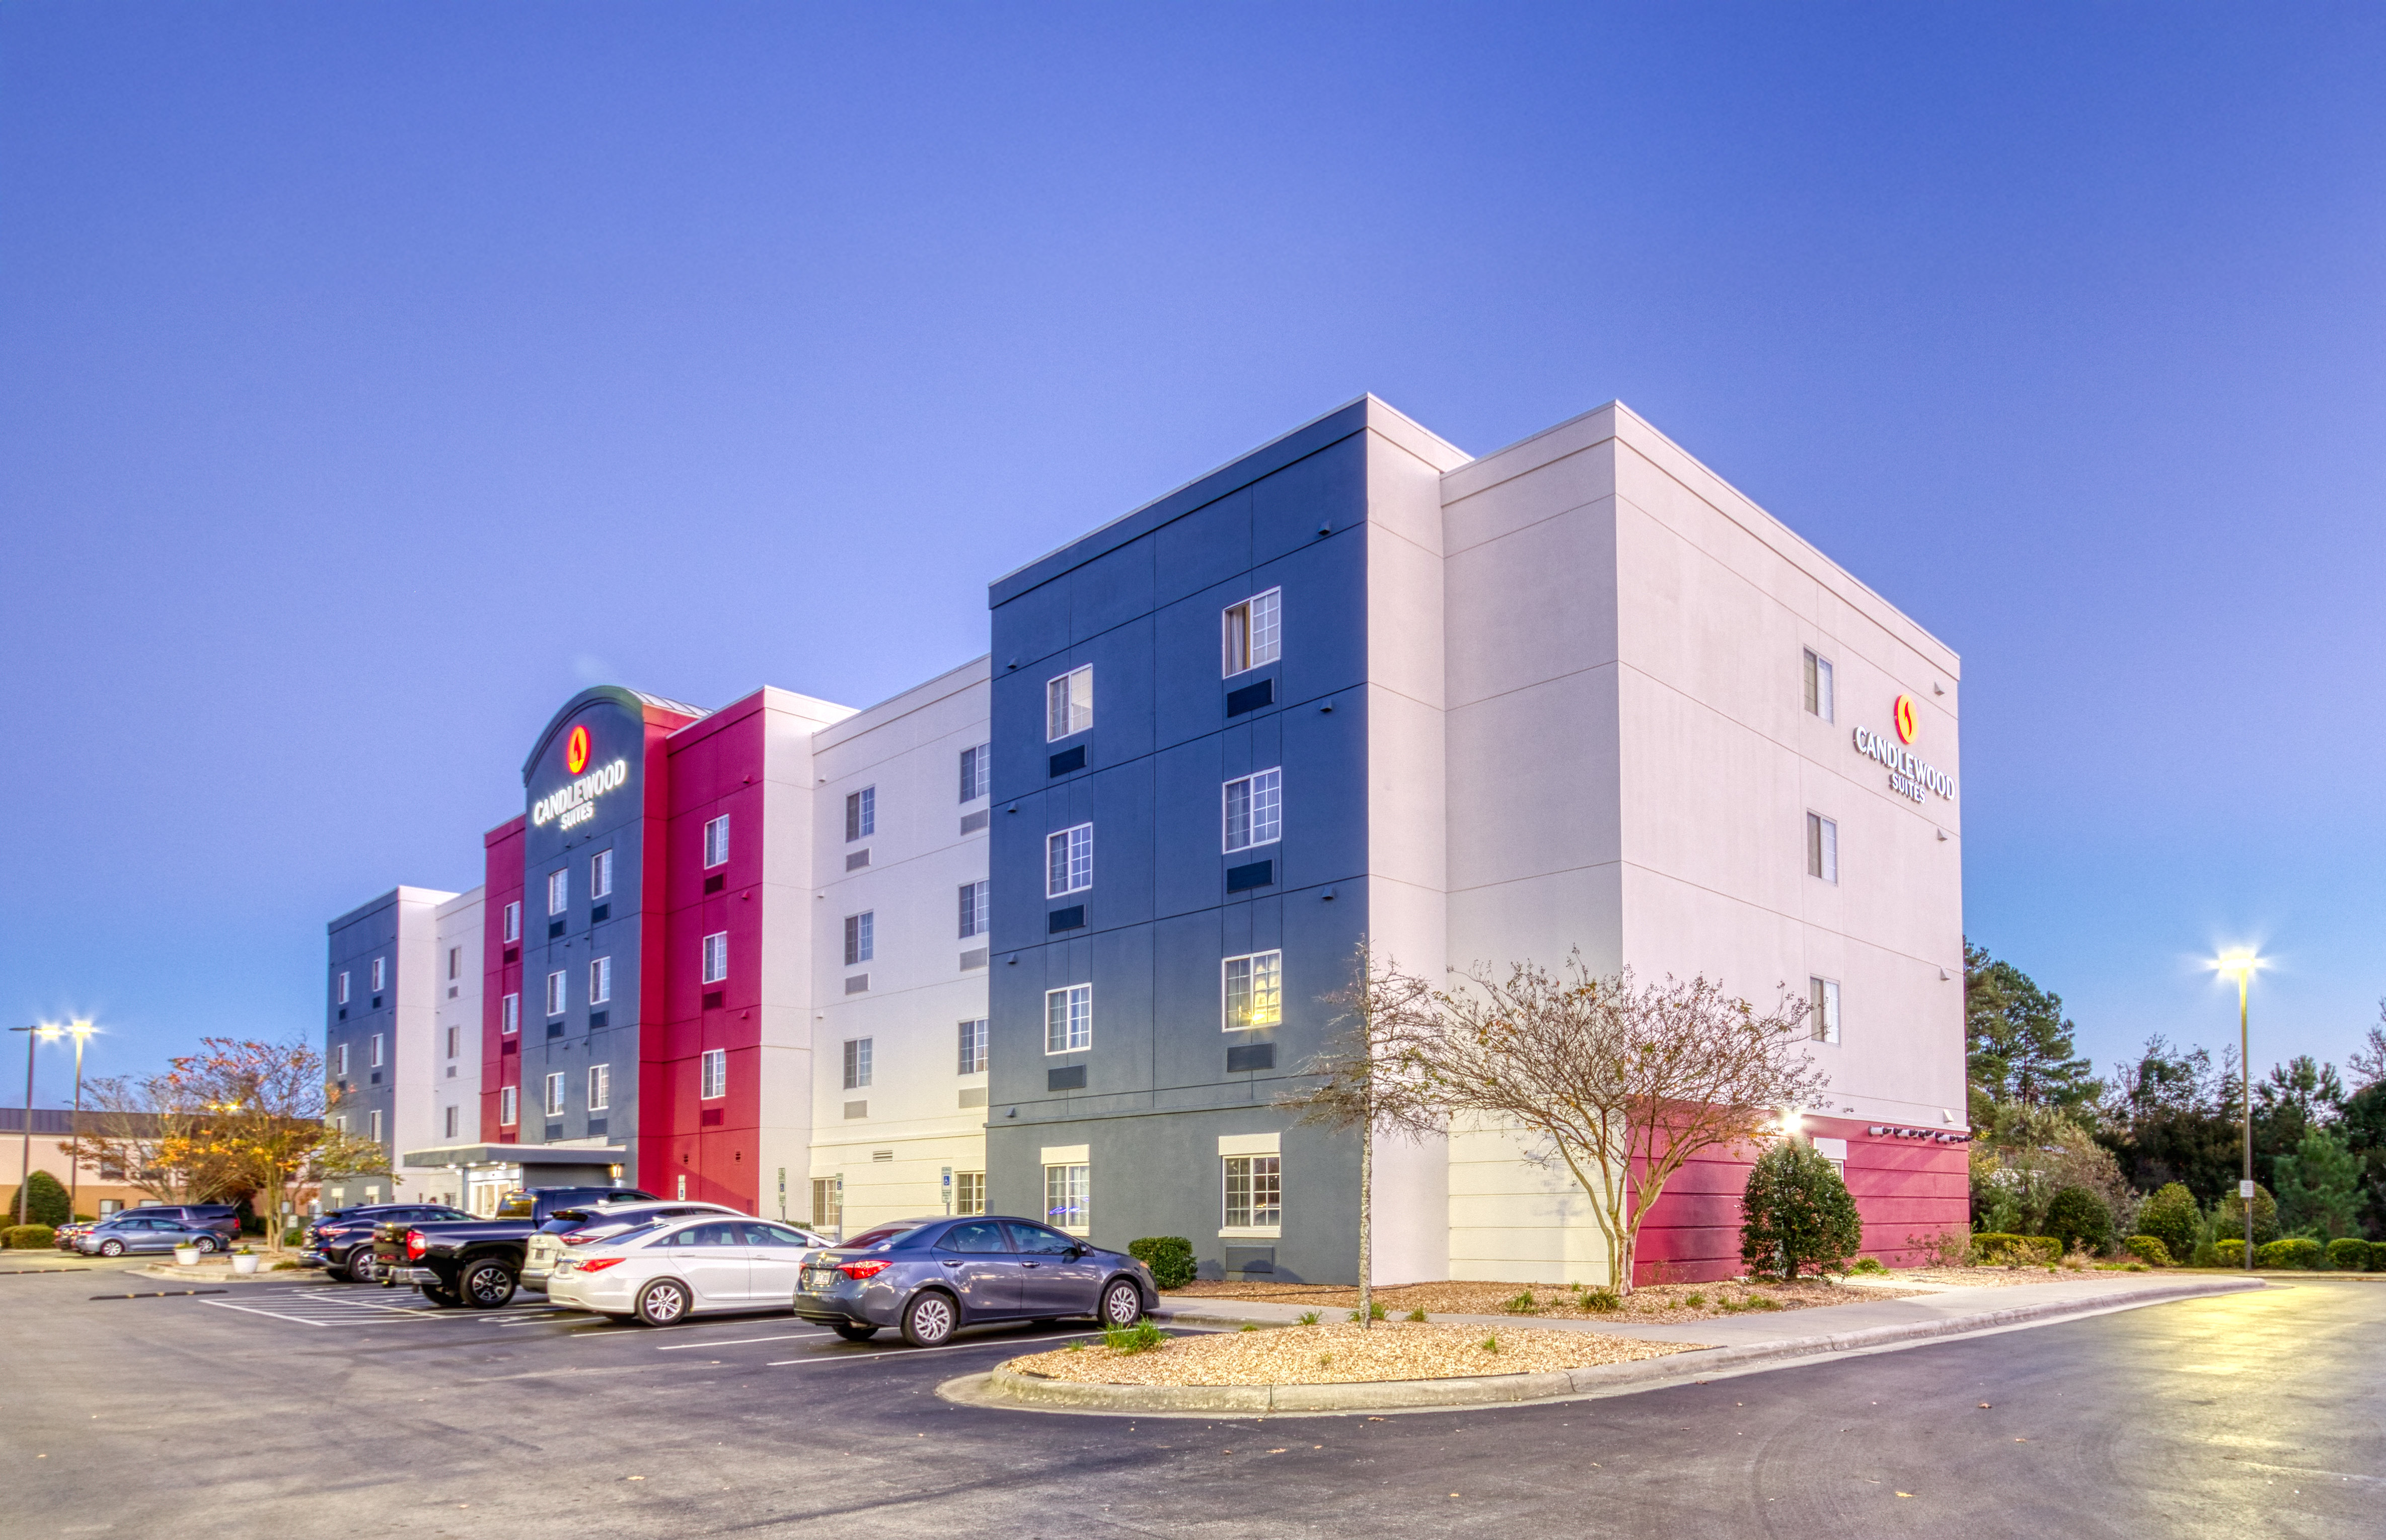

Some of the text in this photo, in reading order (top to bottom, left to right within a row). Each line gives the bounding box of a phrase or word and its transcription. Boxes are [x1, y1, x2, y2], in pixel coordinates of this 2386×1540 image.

[1853, 726, 1956, 800] CANDLEWOOD
[534, 759, 626, 825] CANDLEWOOD
[1890, 773, 1925, 804] SUITES
[560, 801, 593, 829] SUITES
